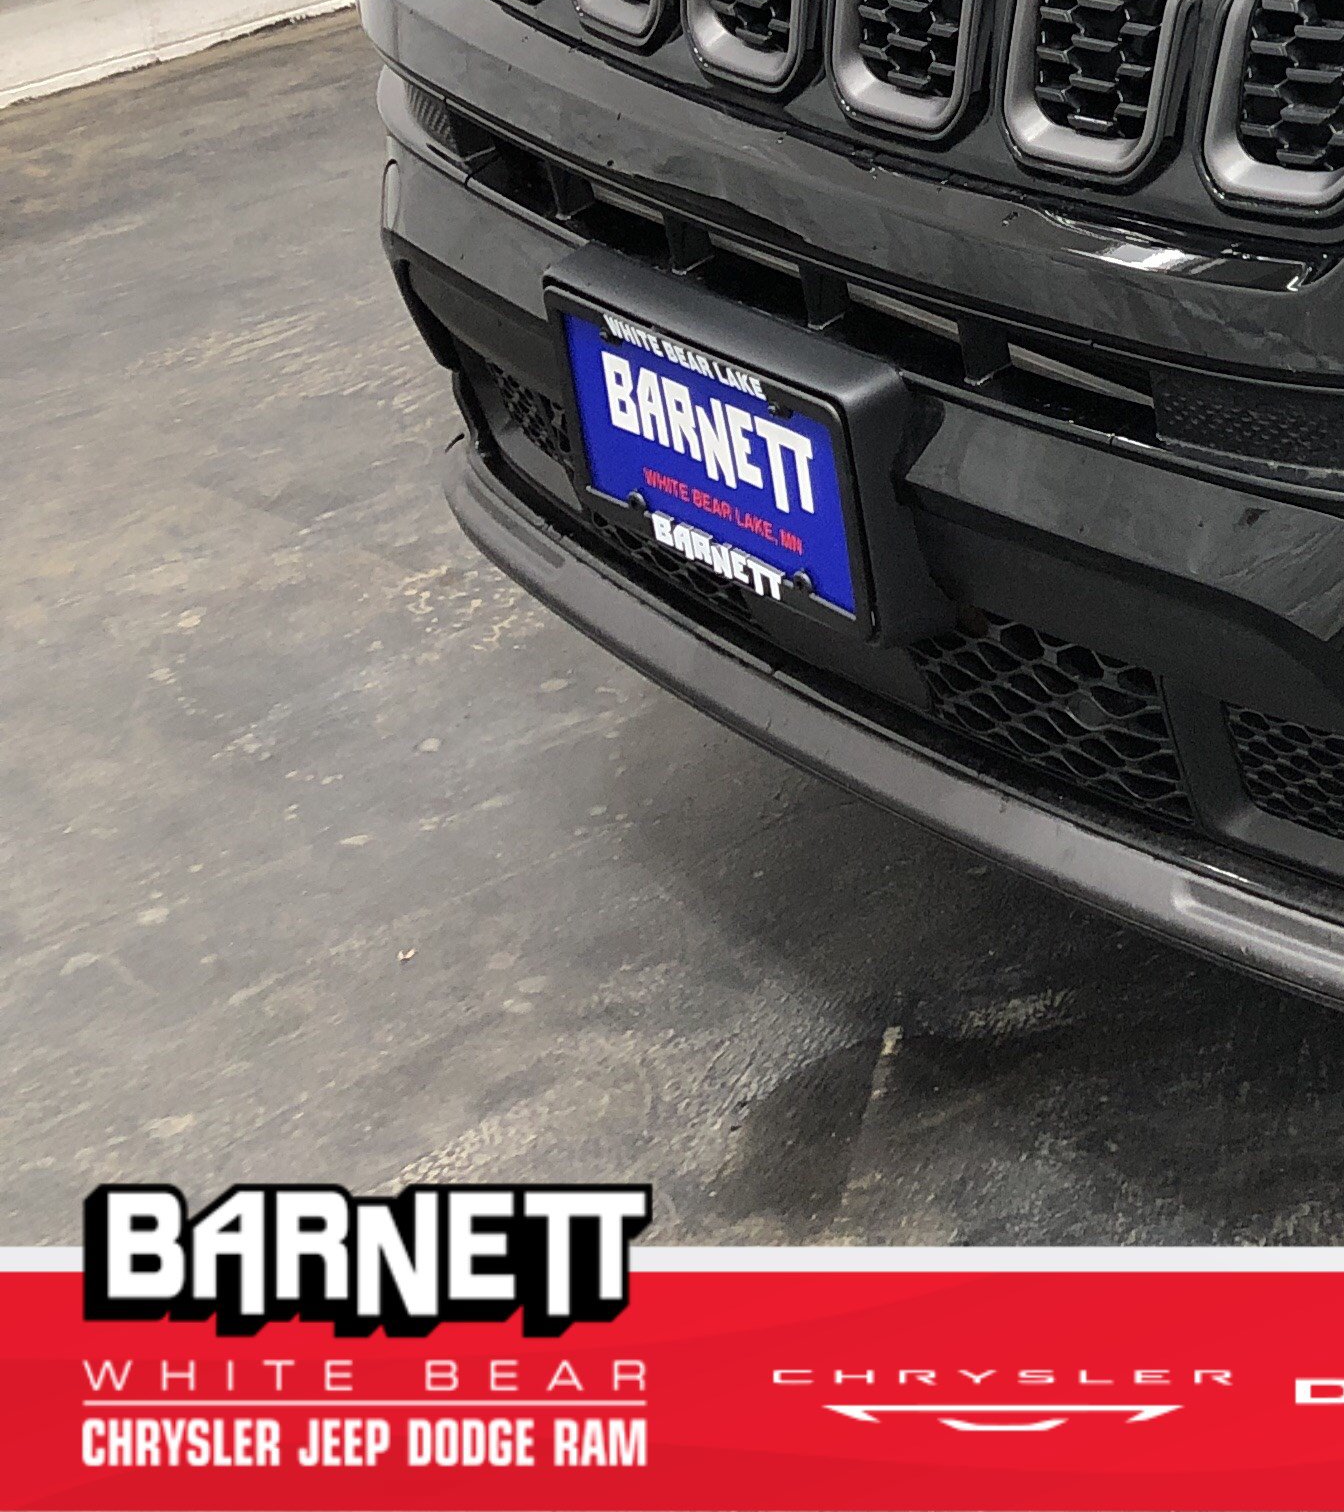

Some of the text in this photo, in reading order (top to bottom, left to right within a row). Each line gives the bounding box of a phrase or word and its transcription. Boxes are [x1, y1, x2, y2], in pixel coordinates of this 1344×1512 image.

[602, 313, 768, 402] WHITE BEAR LAKE
[600, 349, 815, 515] BARNETT
[642, 465, 690, 503] WHITE
[692, 487, 732, 522] BEAR
[734, 502, 778, 544] LAKE,
[649, 512, 784, 602] BARNETT
